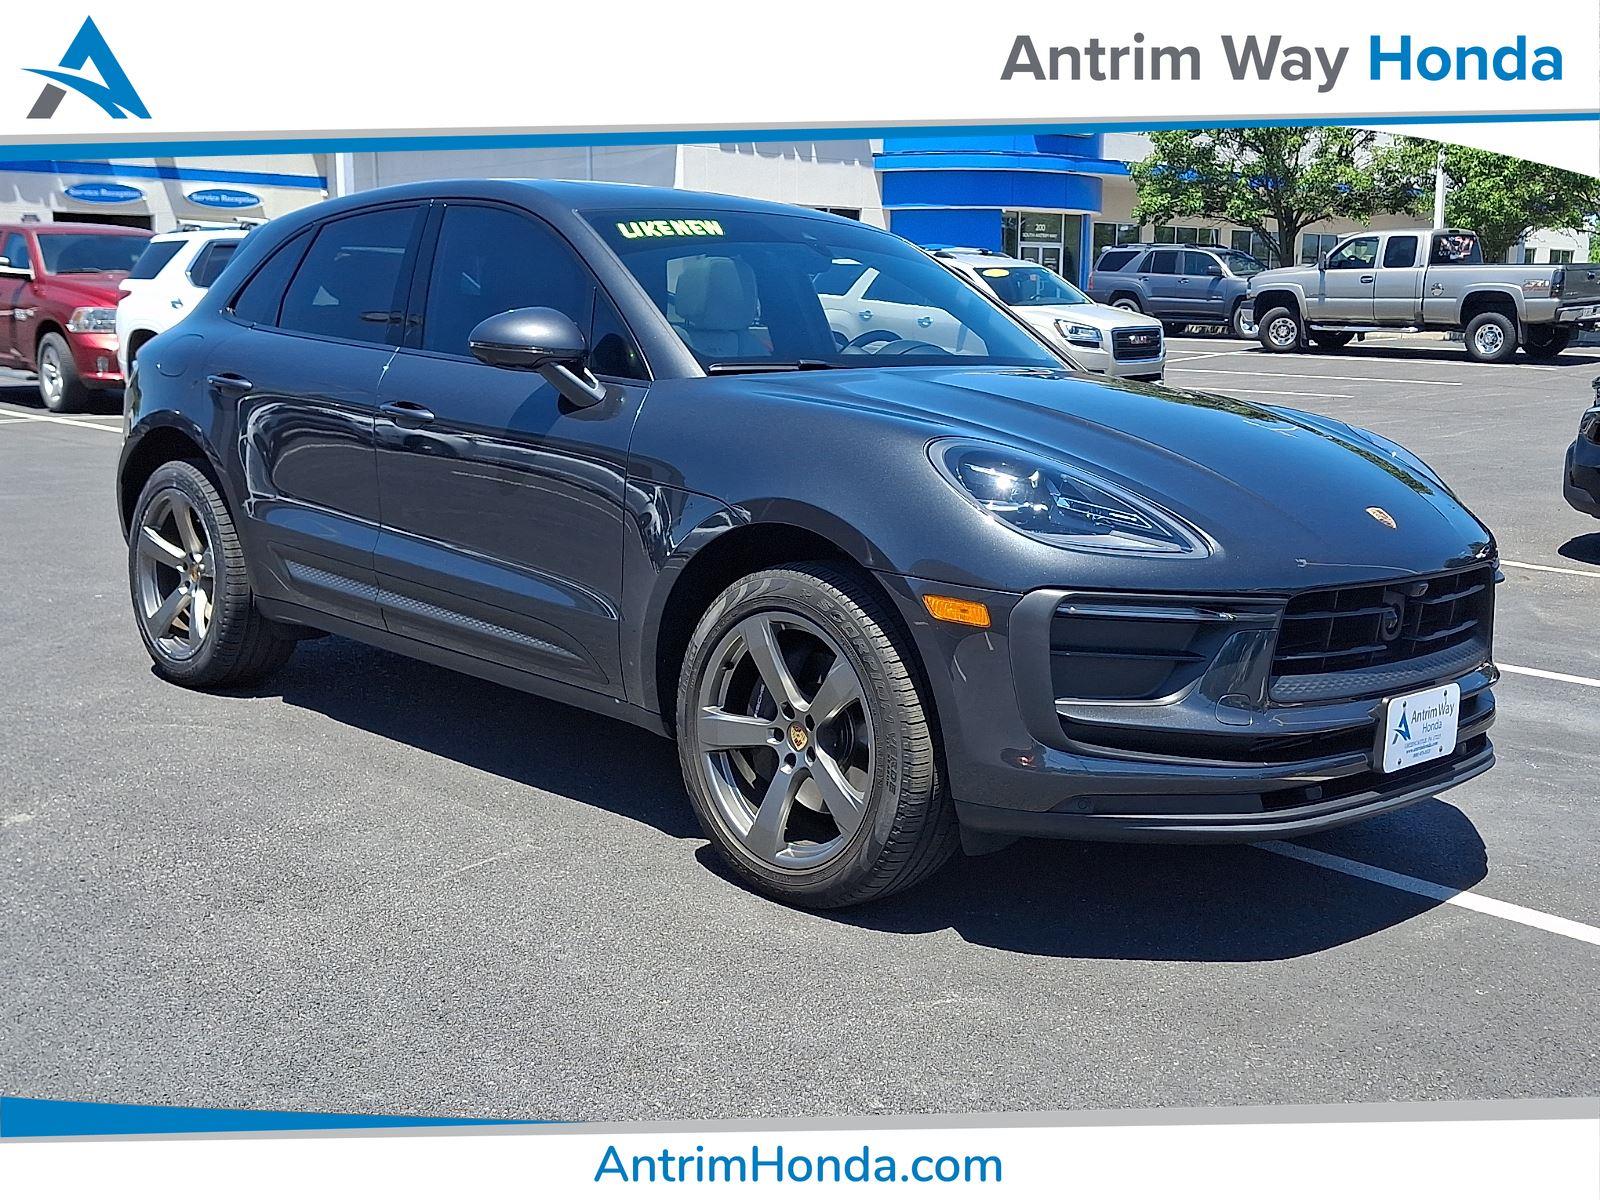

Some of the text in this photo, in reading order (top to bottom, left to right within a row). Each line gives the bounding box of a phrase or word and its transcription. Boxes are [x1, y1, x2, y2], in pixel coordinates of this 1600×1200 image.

[1035, 223, 1046, 231] 200
[1411, 702, 1455, 724] Antrim Way
[1422, 720, 1443, 733] Honda
